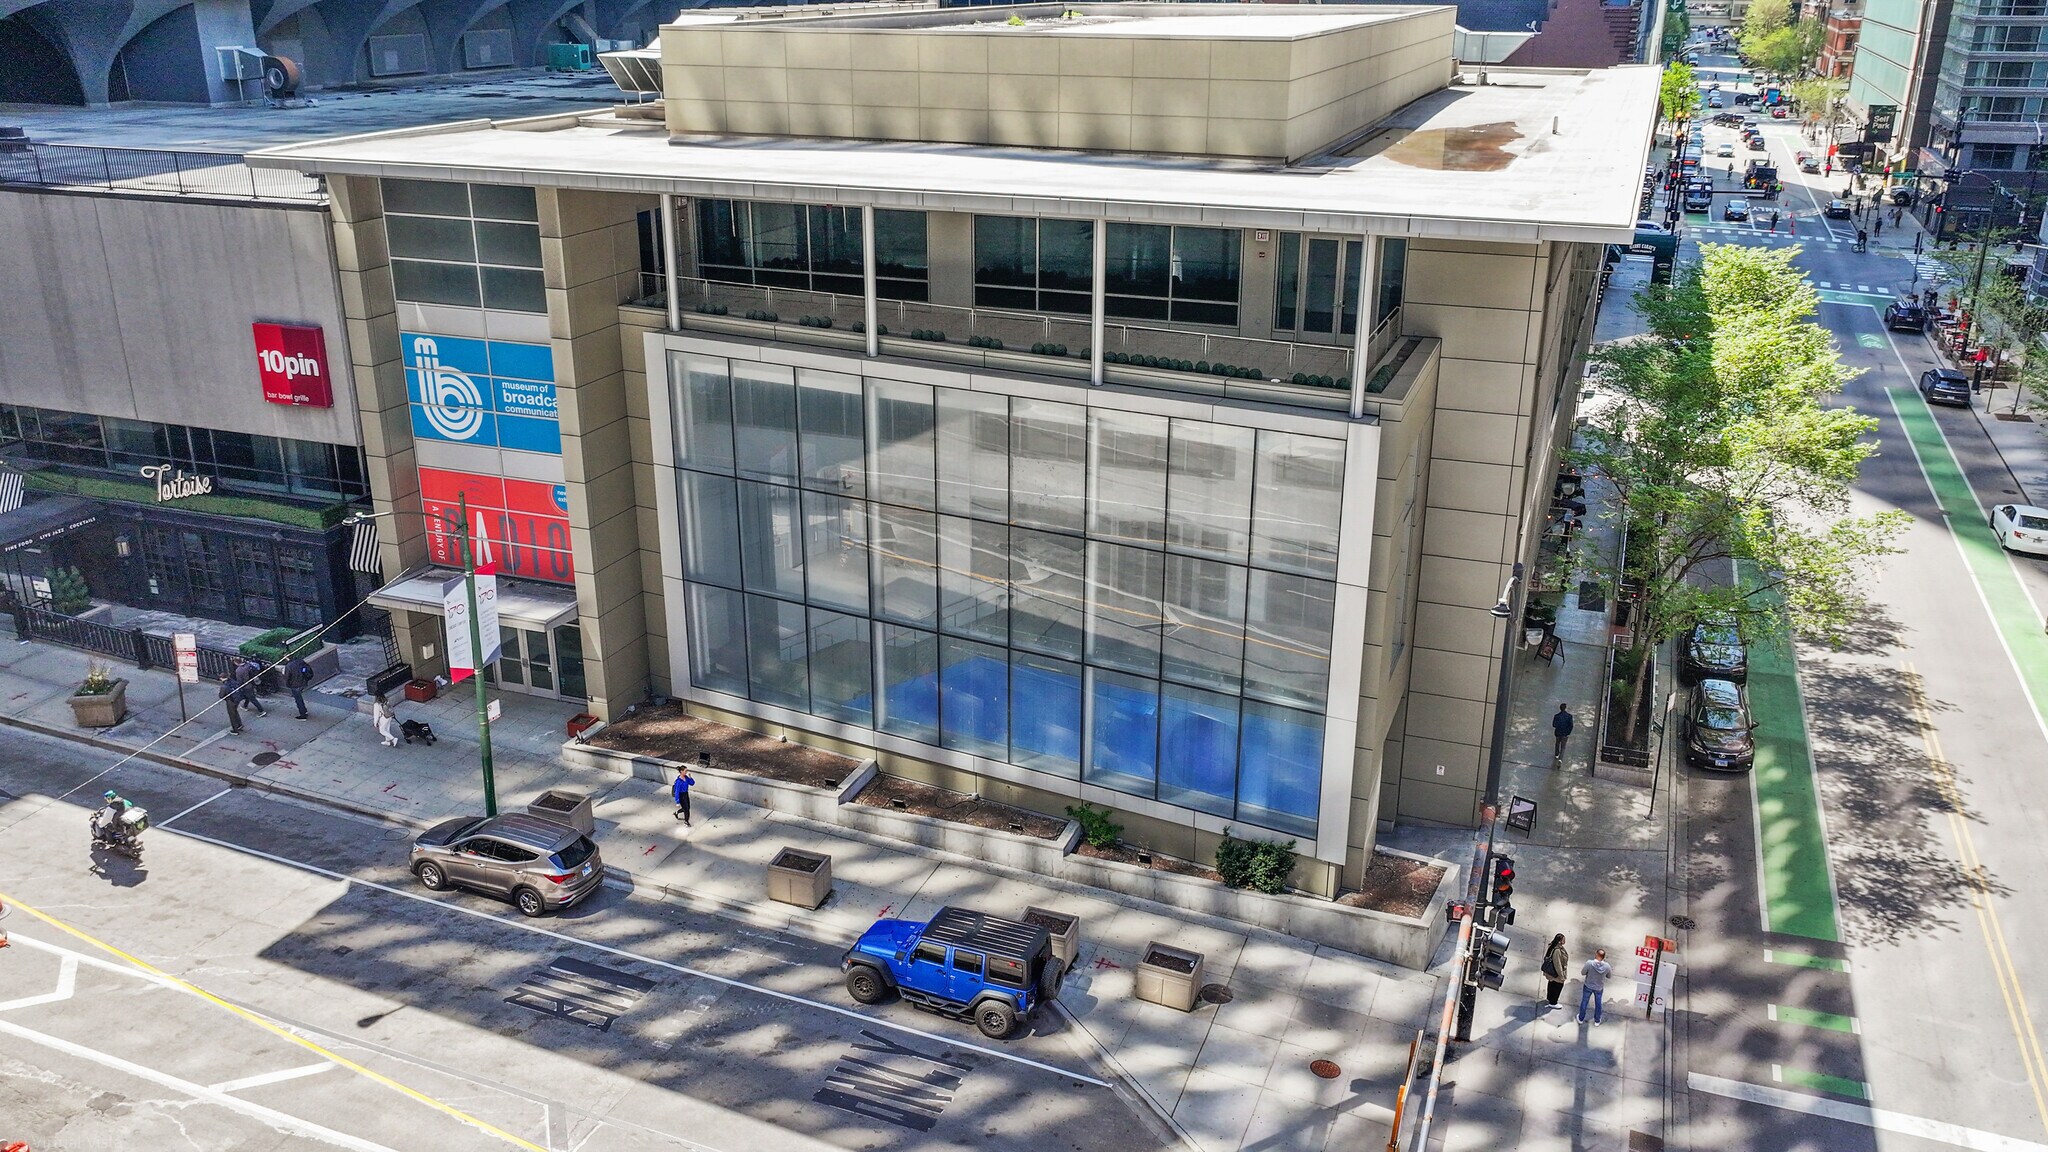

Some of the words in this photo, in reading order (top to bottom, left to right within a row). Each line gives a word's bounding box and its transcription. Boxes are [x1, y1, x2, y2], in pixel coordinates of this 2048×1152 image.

[259, 349, 319, 380] 10pin
[502, 382, 539, 392] museum
[540, 385, 548, 393] of
[278, 391, 293, 400] bowl
[294, 394, 309, 402] grille
[141, 464, 212, 502] Tortoise
[18, 539, 33, 547] FOOD
[69, 517, 96, 529] COCKTAILS
[438, 550, 446, 560] OF
[1635, 946, 1655, 959] HSC
